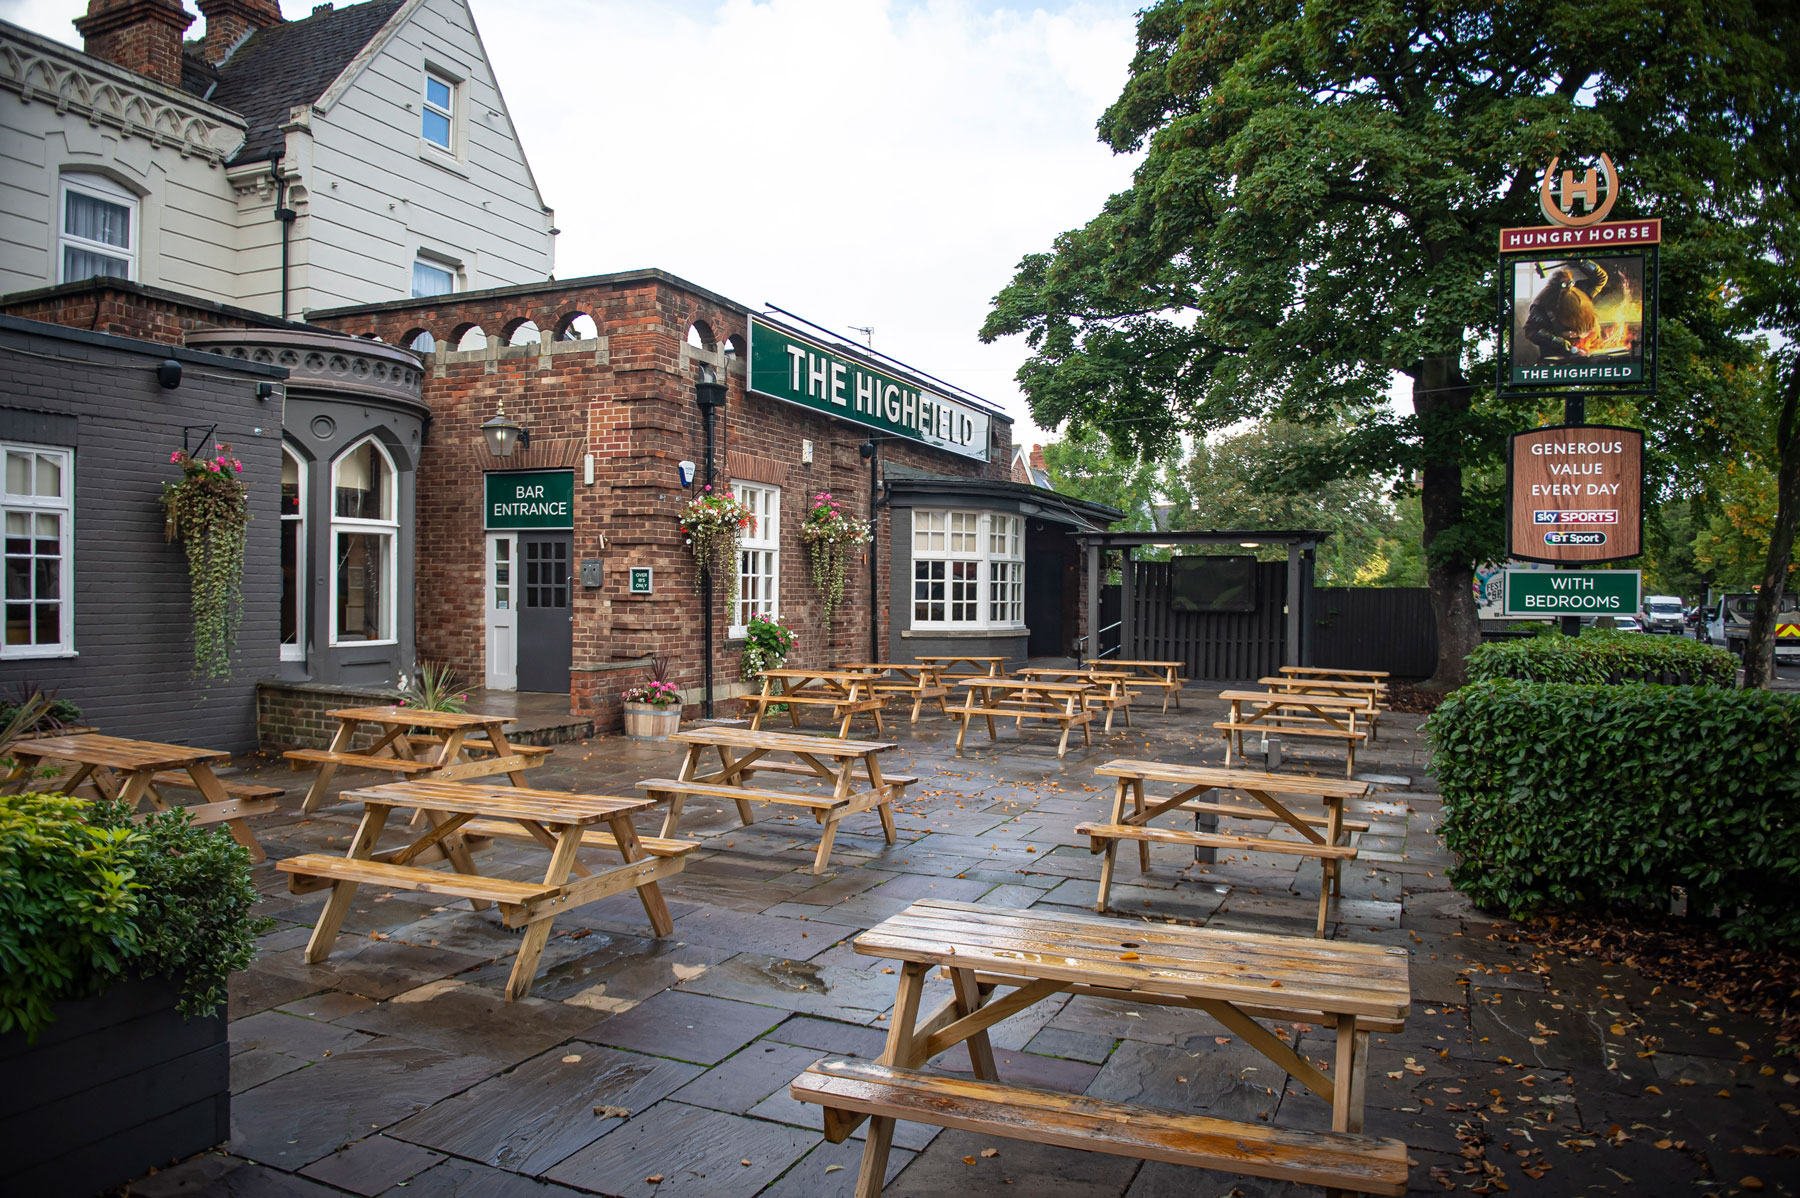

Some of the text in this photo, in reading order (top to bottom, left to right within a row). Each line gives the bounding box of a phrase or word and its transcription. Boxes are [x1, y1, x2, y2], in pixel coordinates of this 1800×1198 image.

[1510, 226, 1650, 246] HUNGRY HORSE
[1522, 367, 1632, 379] THE HIGHFIELD
[787, 344, 975, 447] THE HIGHFIELD
[1531, 442, 1622, 455] GENEROUS
[1550, 463, 1603, 475] VALUE
[516, 485, 544, 498] BAR
[1532, 483, 1620, 496] EVERY DAY
[494, 502, 567, 516] ENTRANCE
[1537, 511, 1614, 523] sky SPORTS
[1552, 534, 1600, 544] BT Sport
[1550, 577, 1594, 590] WITH
[1525, 595, 1620, 608] BEDROOMS
